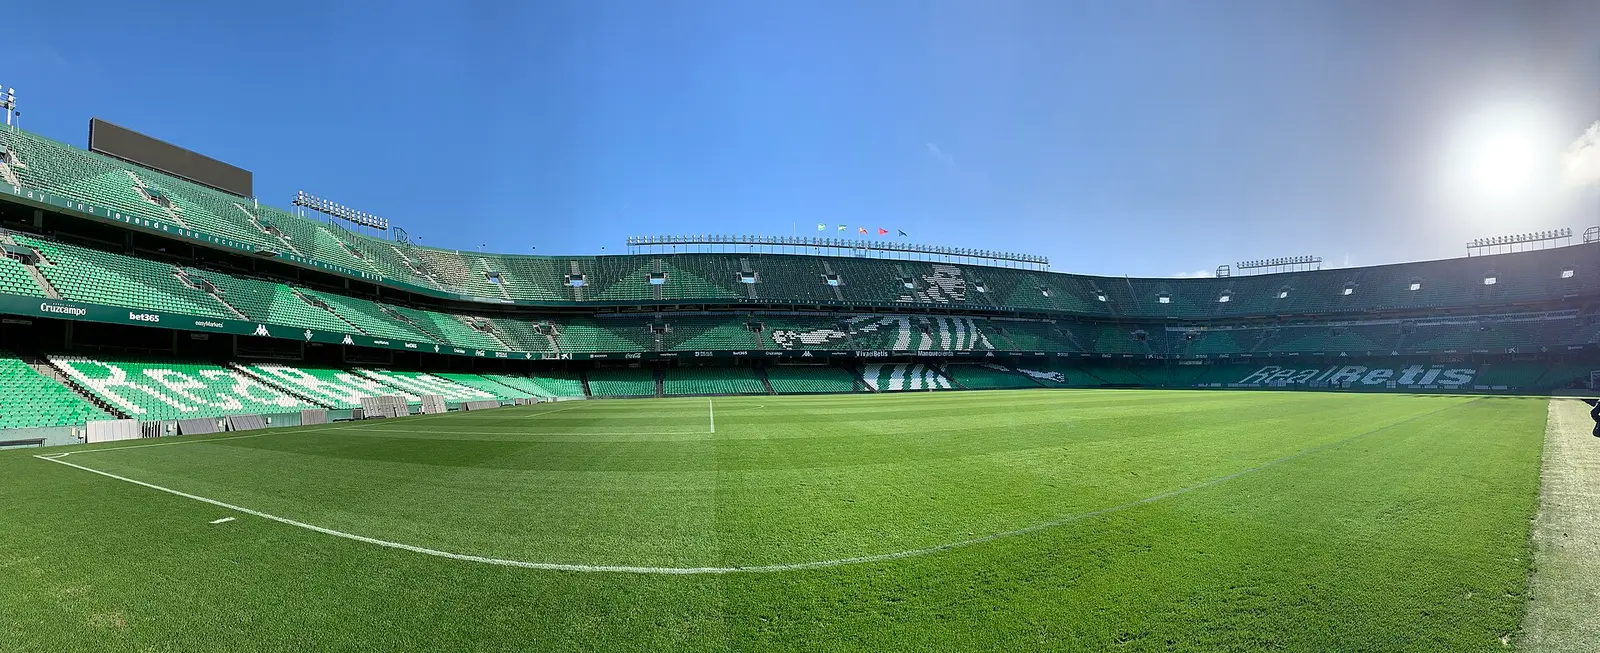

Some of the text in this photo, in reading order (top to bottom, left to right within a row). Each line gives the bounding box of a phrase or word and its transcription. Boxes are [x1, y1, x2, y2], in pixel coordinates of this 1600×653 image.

[13, 186, 45, 202] Hay
[66, 200, 94, 213] una
[107, 209, 168, 231] leyenda
[178, 228, 199, 239] que
[208, 236, 250, 251] recorre
[40, 302, 86, 316] Cruzcampo
[129, 311, 160, 322] bet365
